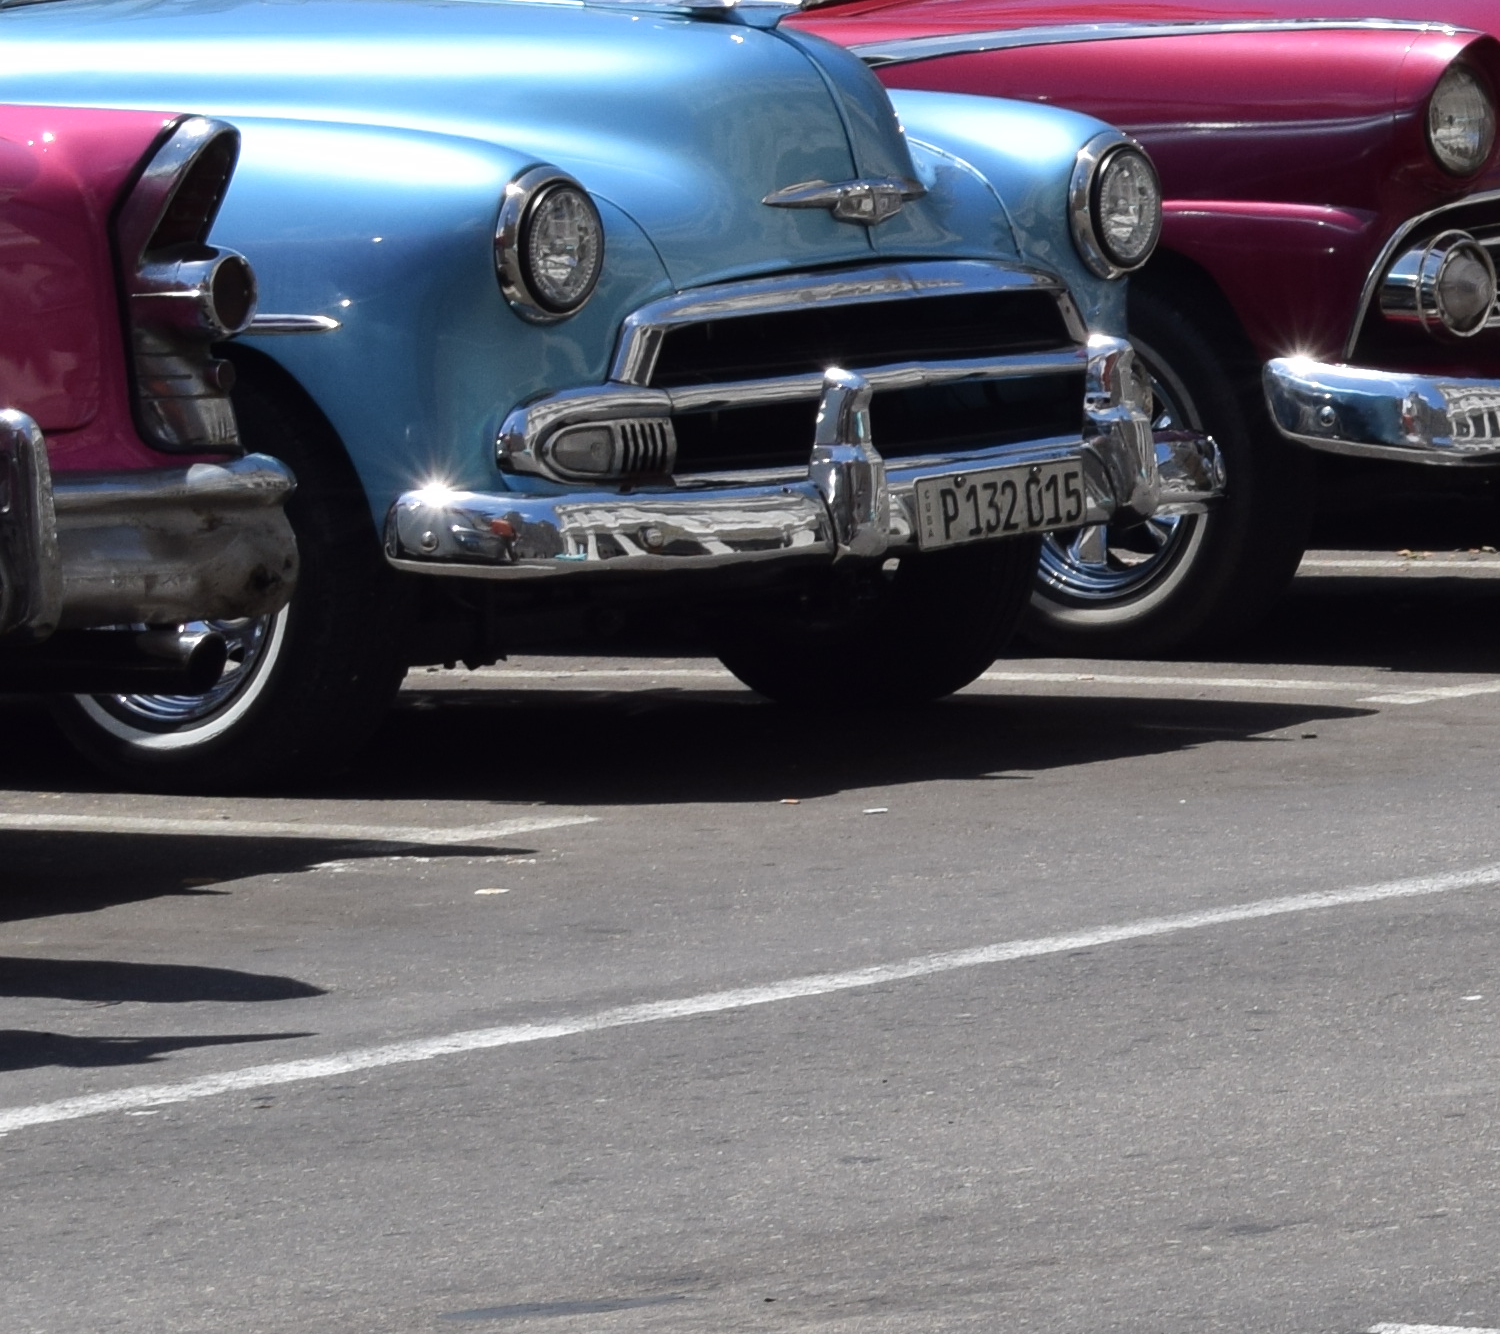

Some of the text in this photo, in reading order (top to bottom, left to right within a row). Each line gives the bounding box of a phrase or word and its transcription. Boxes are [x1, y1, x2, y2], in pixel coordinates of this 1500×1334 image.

[924, 490, 935, 539] CUBA
[940, 471, 1082, 540] P 132 015
